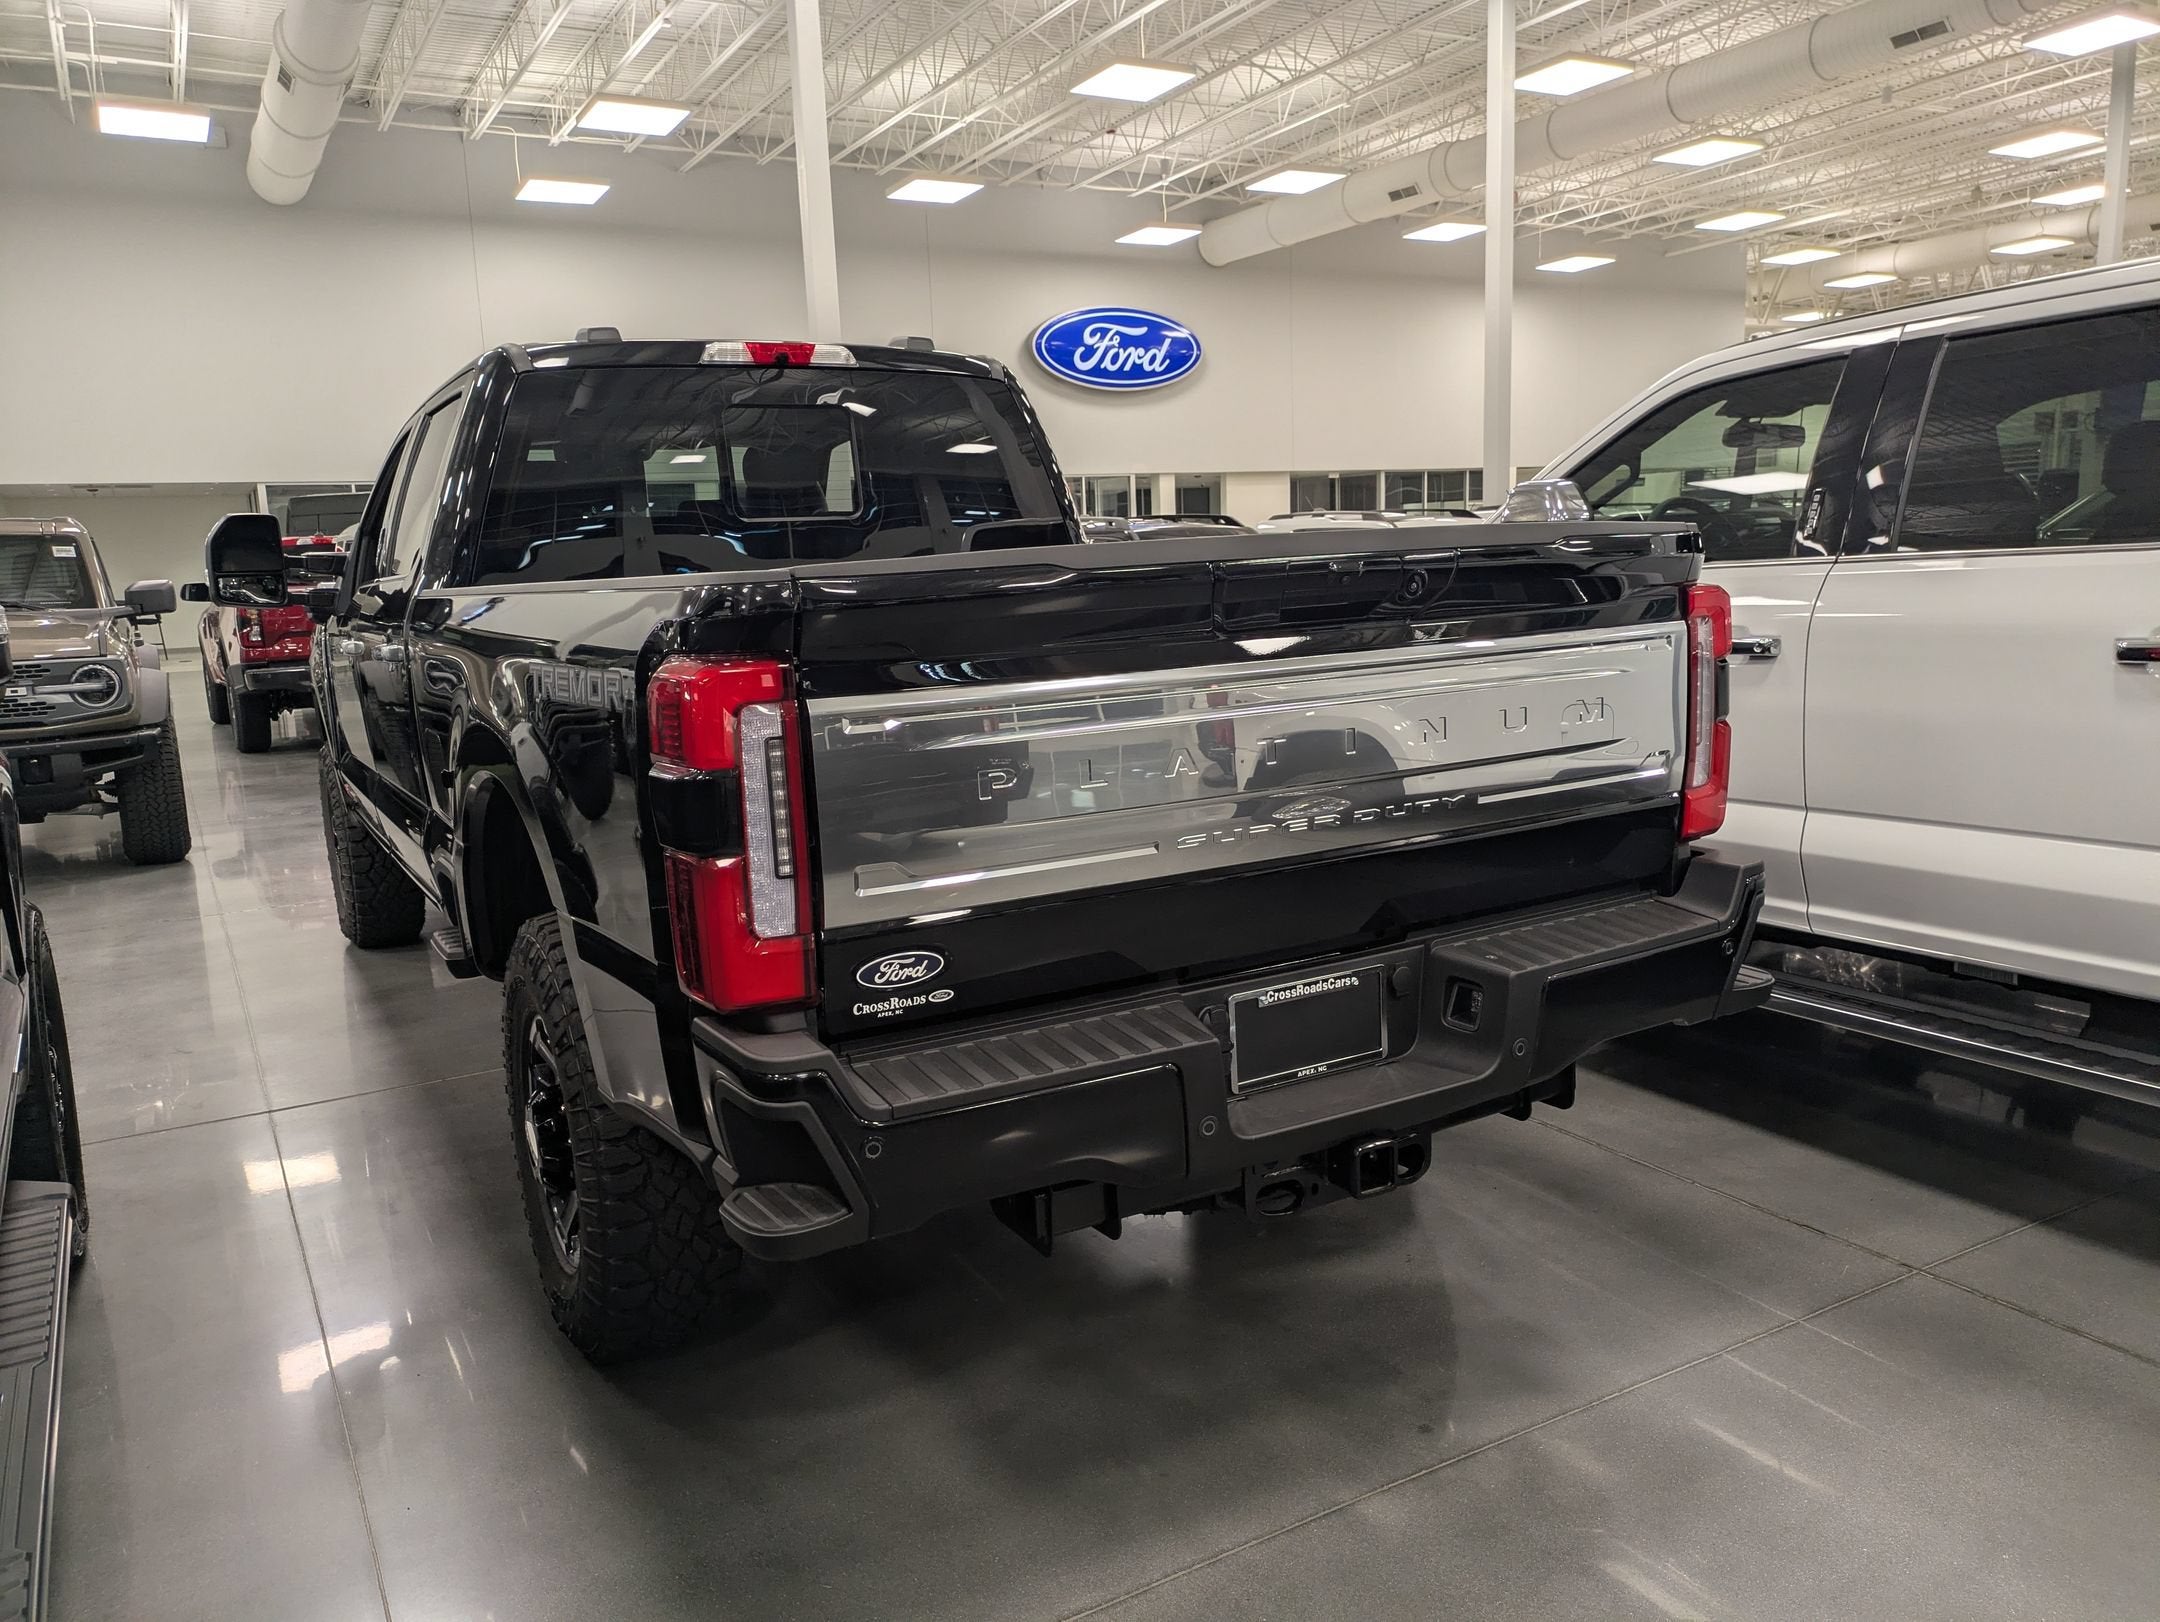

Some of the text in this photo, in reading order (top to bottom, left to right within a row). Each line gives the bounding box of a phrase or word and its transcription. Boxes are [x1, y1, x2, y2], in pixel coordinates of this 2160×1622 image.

[1073, 322, 1172, 372] Ford
[529, 661, 623, 712] TREMOR
[977, 697, 1604, 800] PLATINUM
[1176, 794, 1466, 850] SUPER DUTY
[874, 957, 928, 984] Ford
[1266, 976, 1351, 1003] CrossRoadsCars
